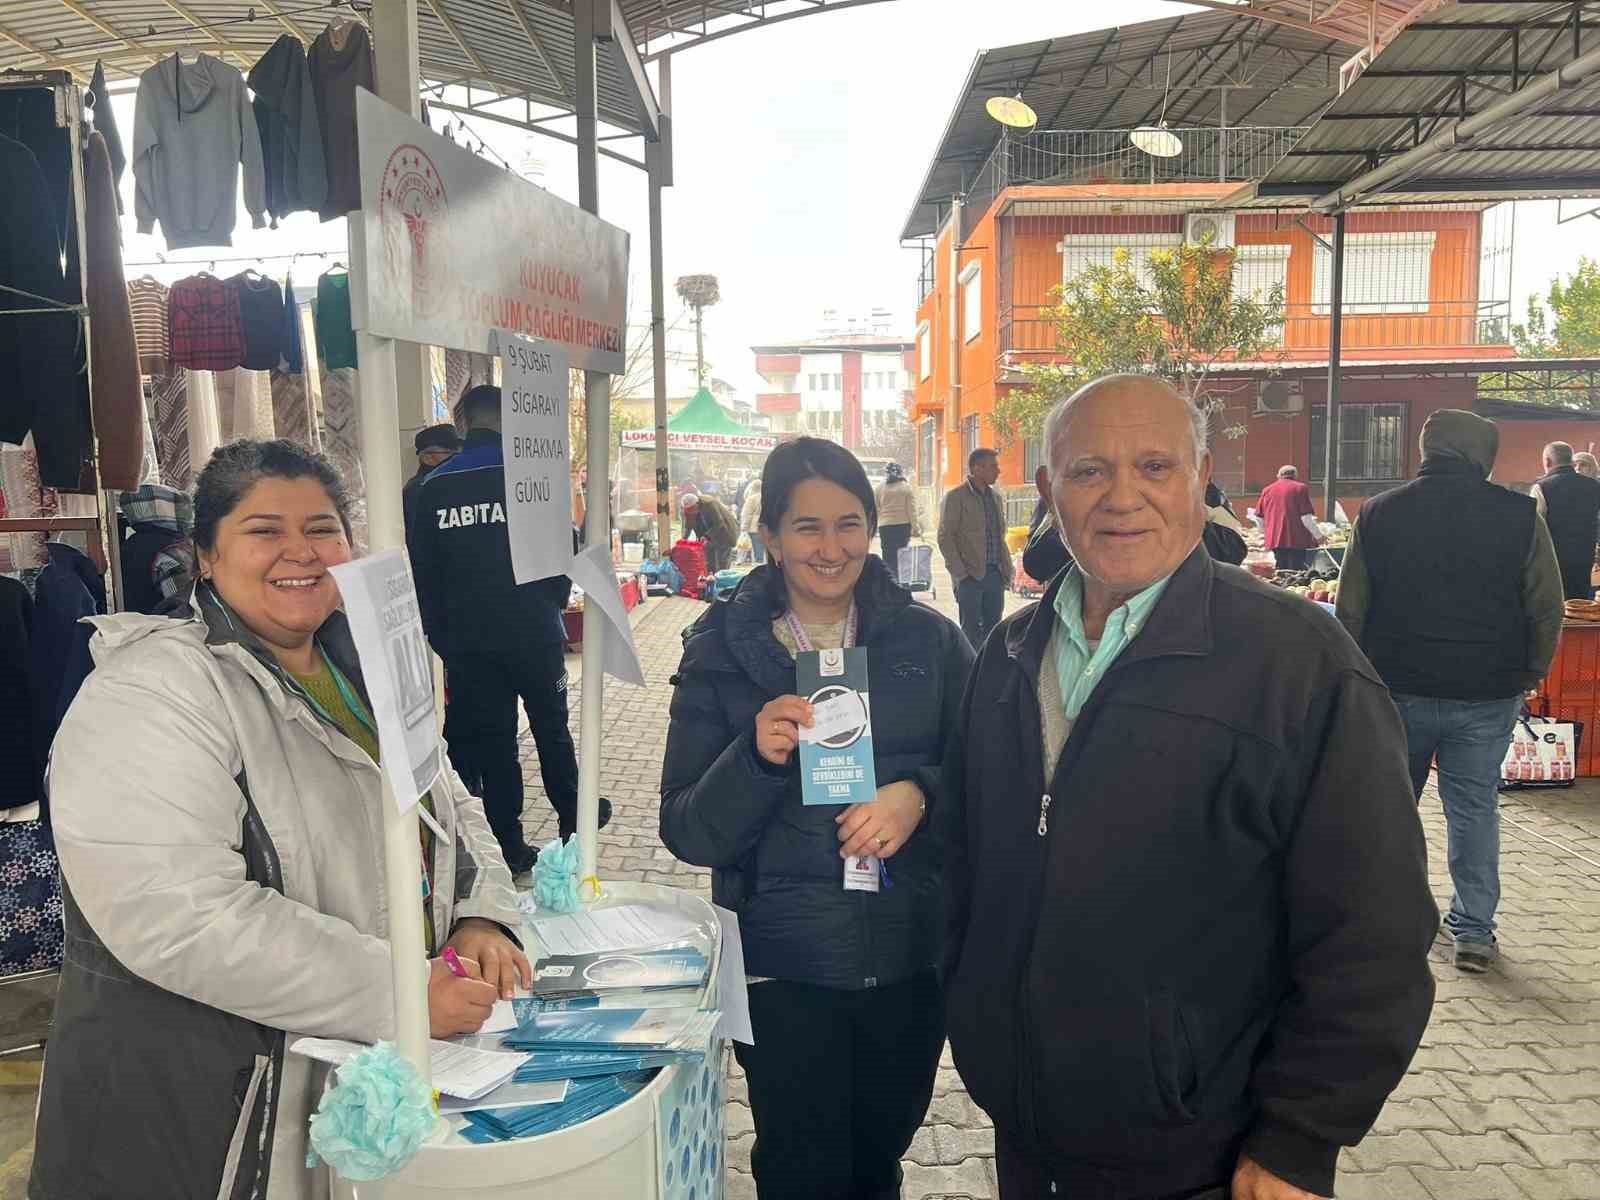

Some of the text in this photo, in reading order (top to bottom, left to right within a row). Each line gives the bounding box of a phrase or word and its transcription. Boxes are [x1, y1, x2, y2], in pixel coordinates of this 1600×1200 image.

[520, 256, 580, 304] KUYUCAK
[526, 303, 575, 345] SAĞLIĞI
[576, 317, 623, 353] MERKEZİ
[508, 345, 552, 375] 9 ŞUBAT
[512, 387, 560, 417] SİGARAYI
[513, 436, 564, 460] BIRAKMA
[683, 433, 728, 445] VEYSEL
[515, 477, 551, 503] GÜNÜ
[437, 502, 506, 530] ZABITA
